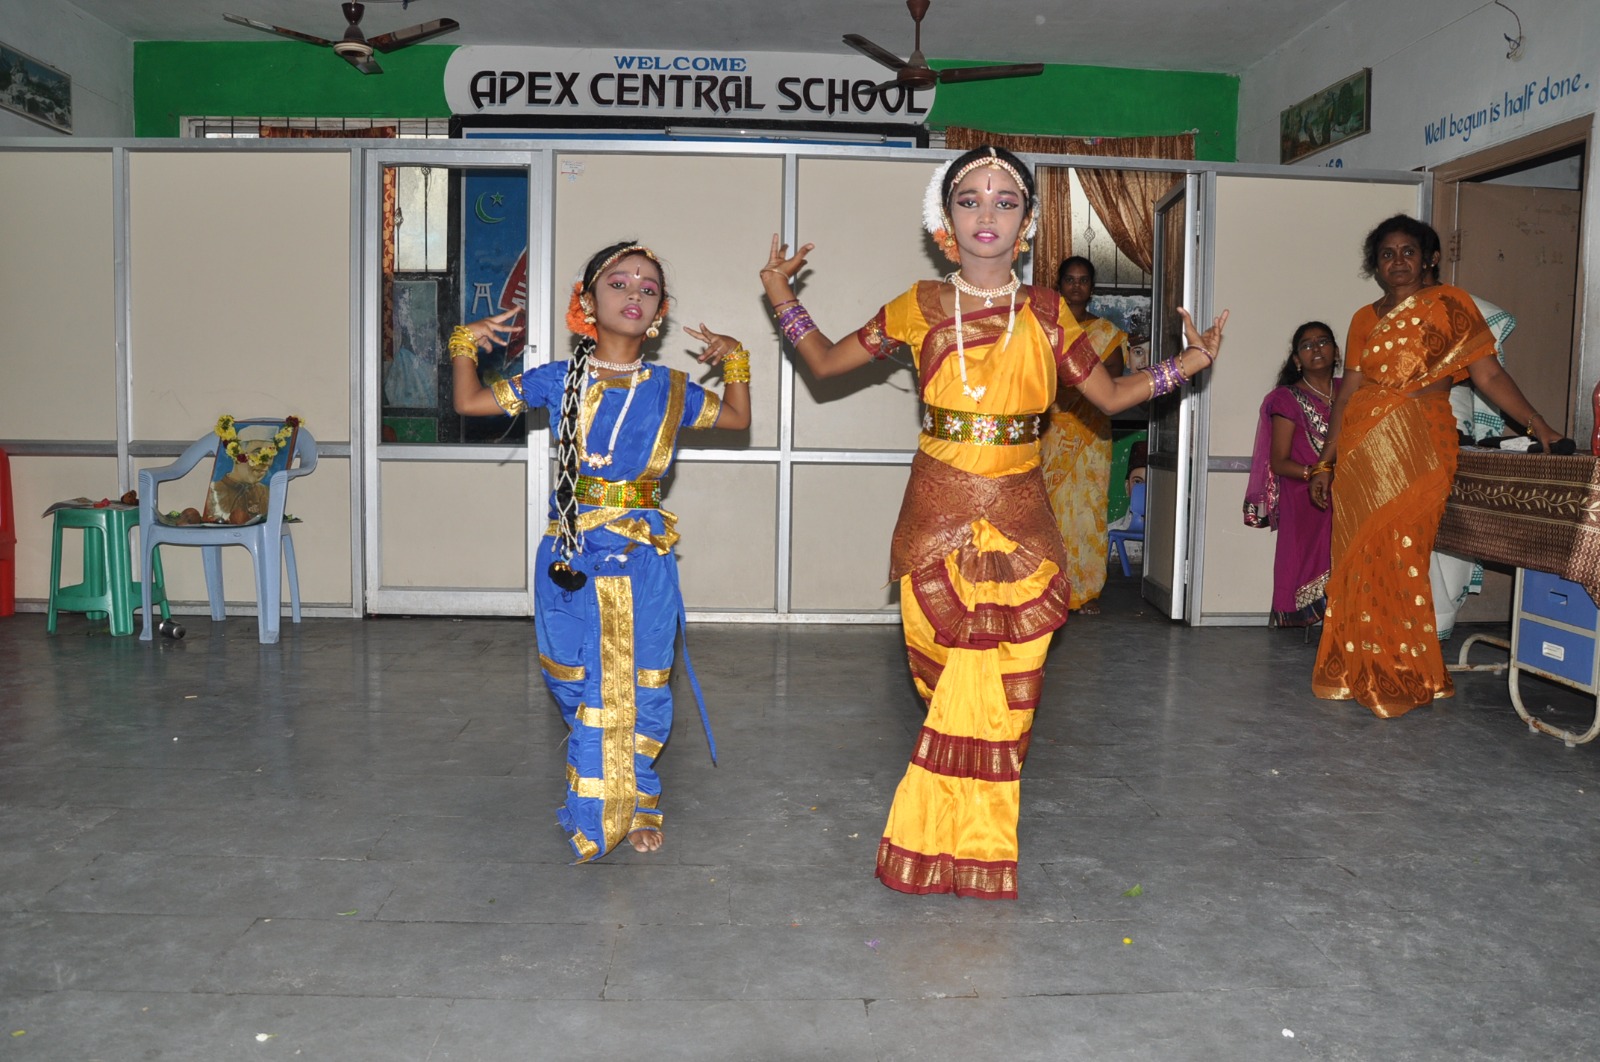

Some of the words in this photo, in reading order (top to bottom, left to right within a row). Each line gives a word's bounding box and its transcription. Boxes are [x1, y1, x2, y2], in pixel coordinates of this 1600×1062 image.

[614, 55, 747, 72] WELCOME
[468, 70, 580, 112] APEX
[588, 73, 767, 114] CENTRAL
[776, 77, 929, 116] SCHOOL
[1424, 116, 1446, 146] Well
[1449, 109, 1487, 142] begun
[1489, 102, 1501, 123] is
[1504, 81, 1537, 118] half
[1538, 73, 1590, 105] done.
